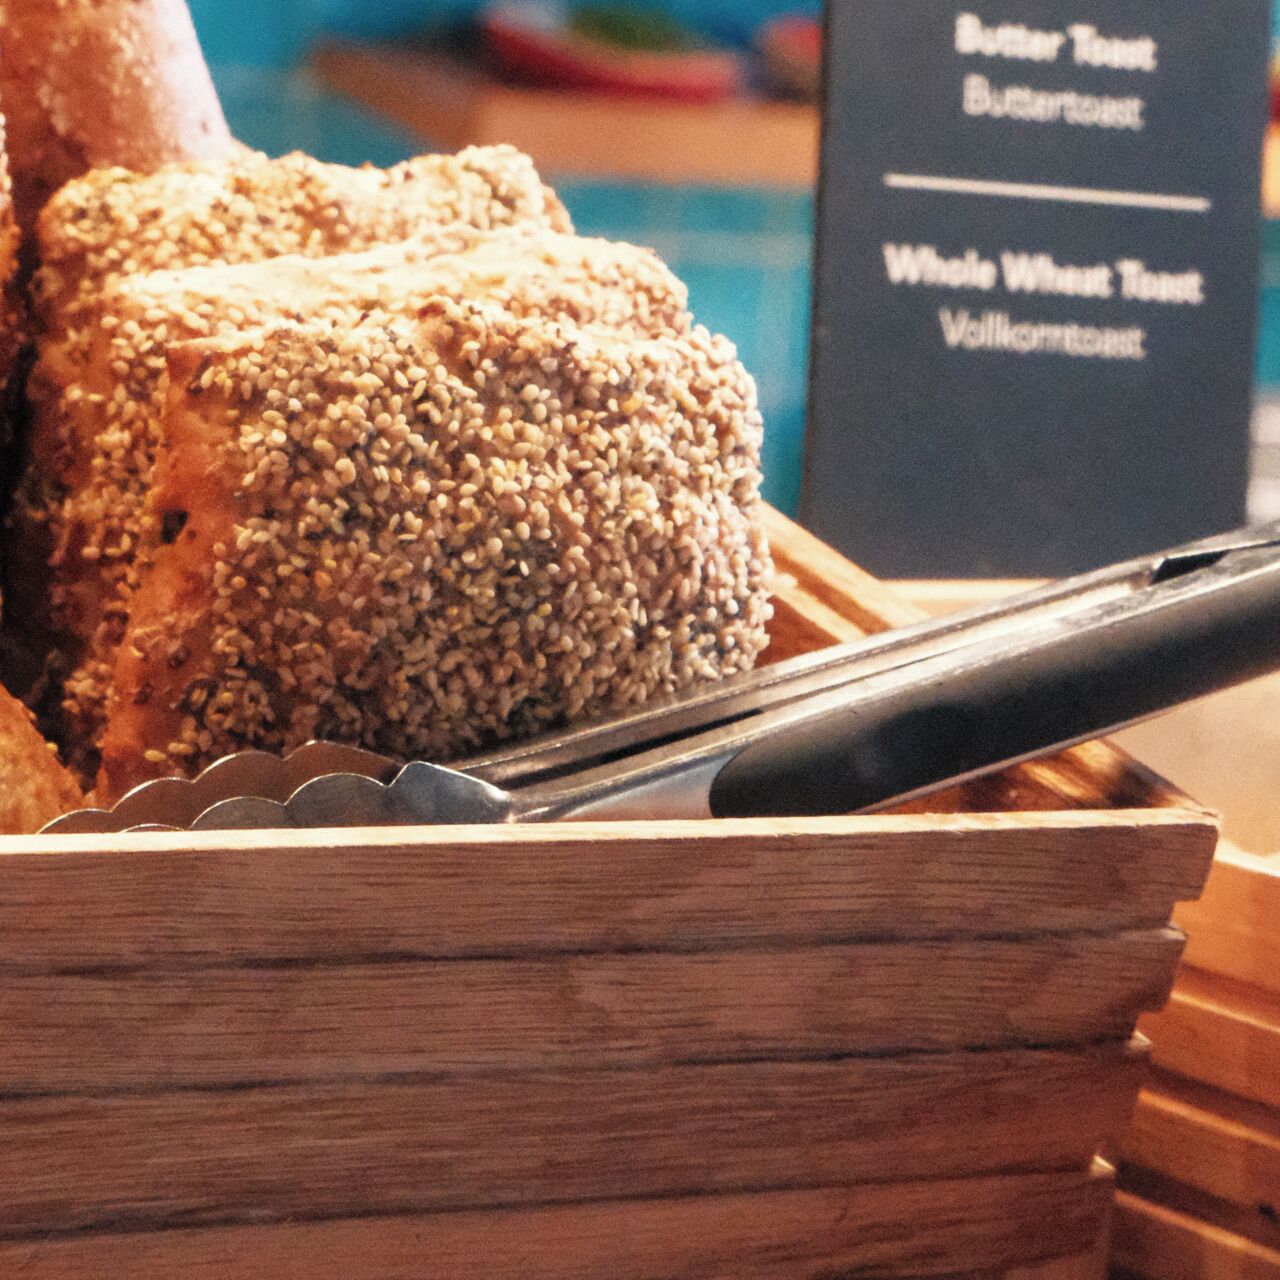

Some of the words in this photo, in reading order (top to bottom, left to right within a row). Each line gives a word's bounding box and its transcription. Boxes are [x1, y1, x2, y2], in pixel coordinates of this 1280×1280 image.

[955, 13, 1066, 62] Butter
[1067, 23, 1157, 71] Toast
[963, 73, 1144, 130] Buttertoast
[883, 243, 997, 290] Whole
[1000, 251, 1113, 298] Wheat
[1115, 259, 1204, 305] Toast
